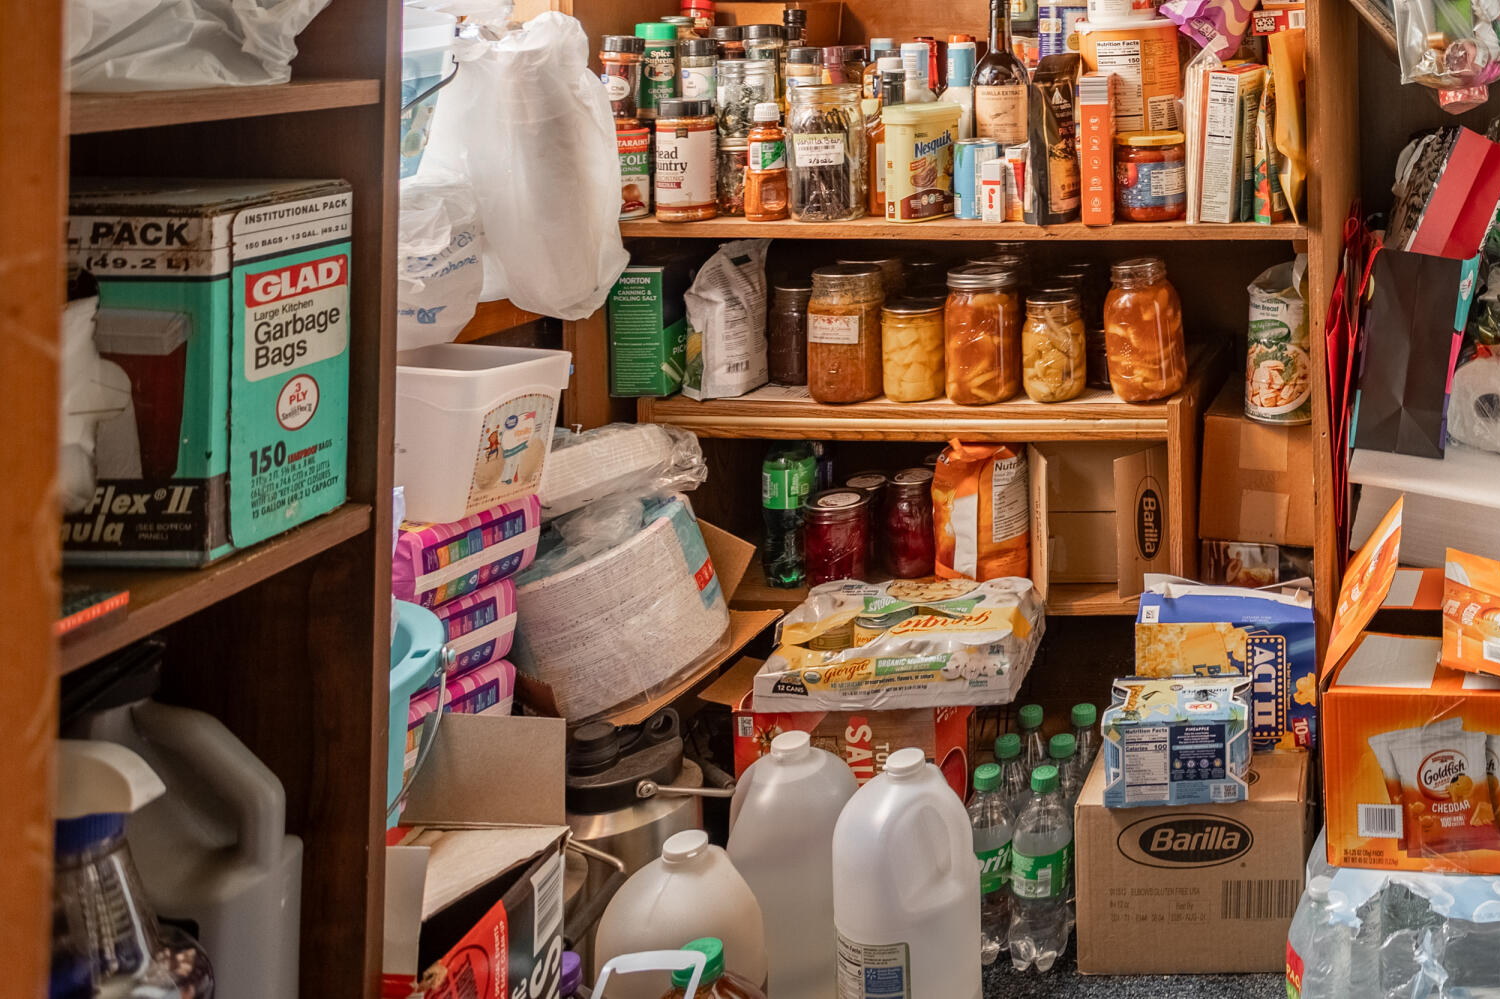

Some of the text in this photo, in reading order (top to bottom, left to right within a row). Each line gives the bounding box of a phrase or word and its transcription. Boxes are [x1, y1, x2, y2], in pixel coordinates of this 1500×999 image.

[650, 50, 671, 59] Spice
[914, 129, 952, 159] Nesquik
[620, 154, 647, 166] EOLE
[656, 162, 688, 174] untry
[245, 198, 348, 225] INSTITUTIONAL PACK
[89, 220, 192, 247] PACK
[246, 241, 260, 250] 150
[261, 236, 283, 248] BAGS
[291, 233, 300, 241] 13
[301, 229, 319, 239] GAL.
[85, 256, 192, 272] (49.2 L)
[252, 260, 341, 302] GLAD
[618, 277, 651, 285] MORTON
[253, 298, 314, 322] Large Kitchen
[254, 306, 341, 346] Garbage
[254, 338, 308, 371] Bags
[288, 389, 308, 406] PLY
[295, 382, 302, 394] 3
[250, 438, 333, 478] 150 BAGS
[85, 485, 155, 515] Flex
[260, 497, 287, 515] GALLON
[311, 475, 339, 495] CAPACITY
[1143, 496, 1158, 554] Barilla
[822, 659, 872, 684] Giorgio
[877, 656, 906, 668] ORGANIC
[1254, 645, 1277, 729] ACT II
[1188, 702, 1213, 710] Dole
[1293, 718, 1309, 735] 10
[1154, 743, 1168, 751] 100
[1423, 760, 1466, 786] Goldfish
[1431, 799, 1471, 813] CHEDDAR
[1151, 826, 1241, 852] Barilla
